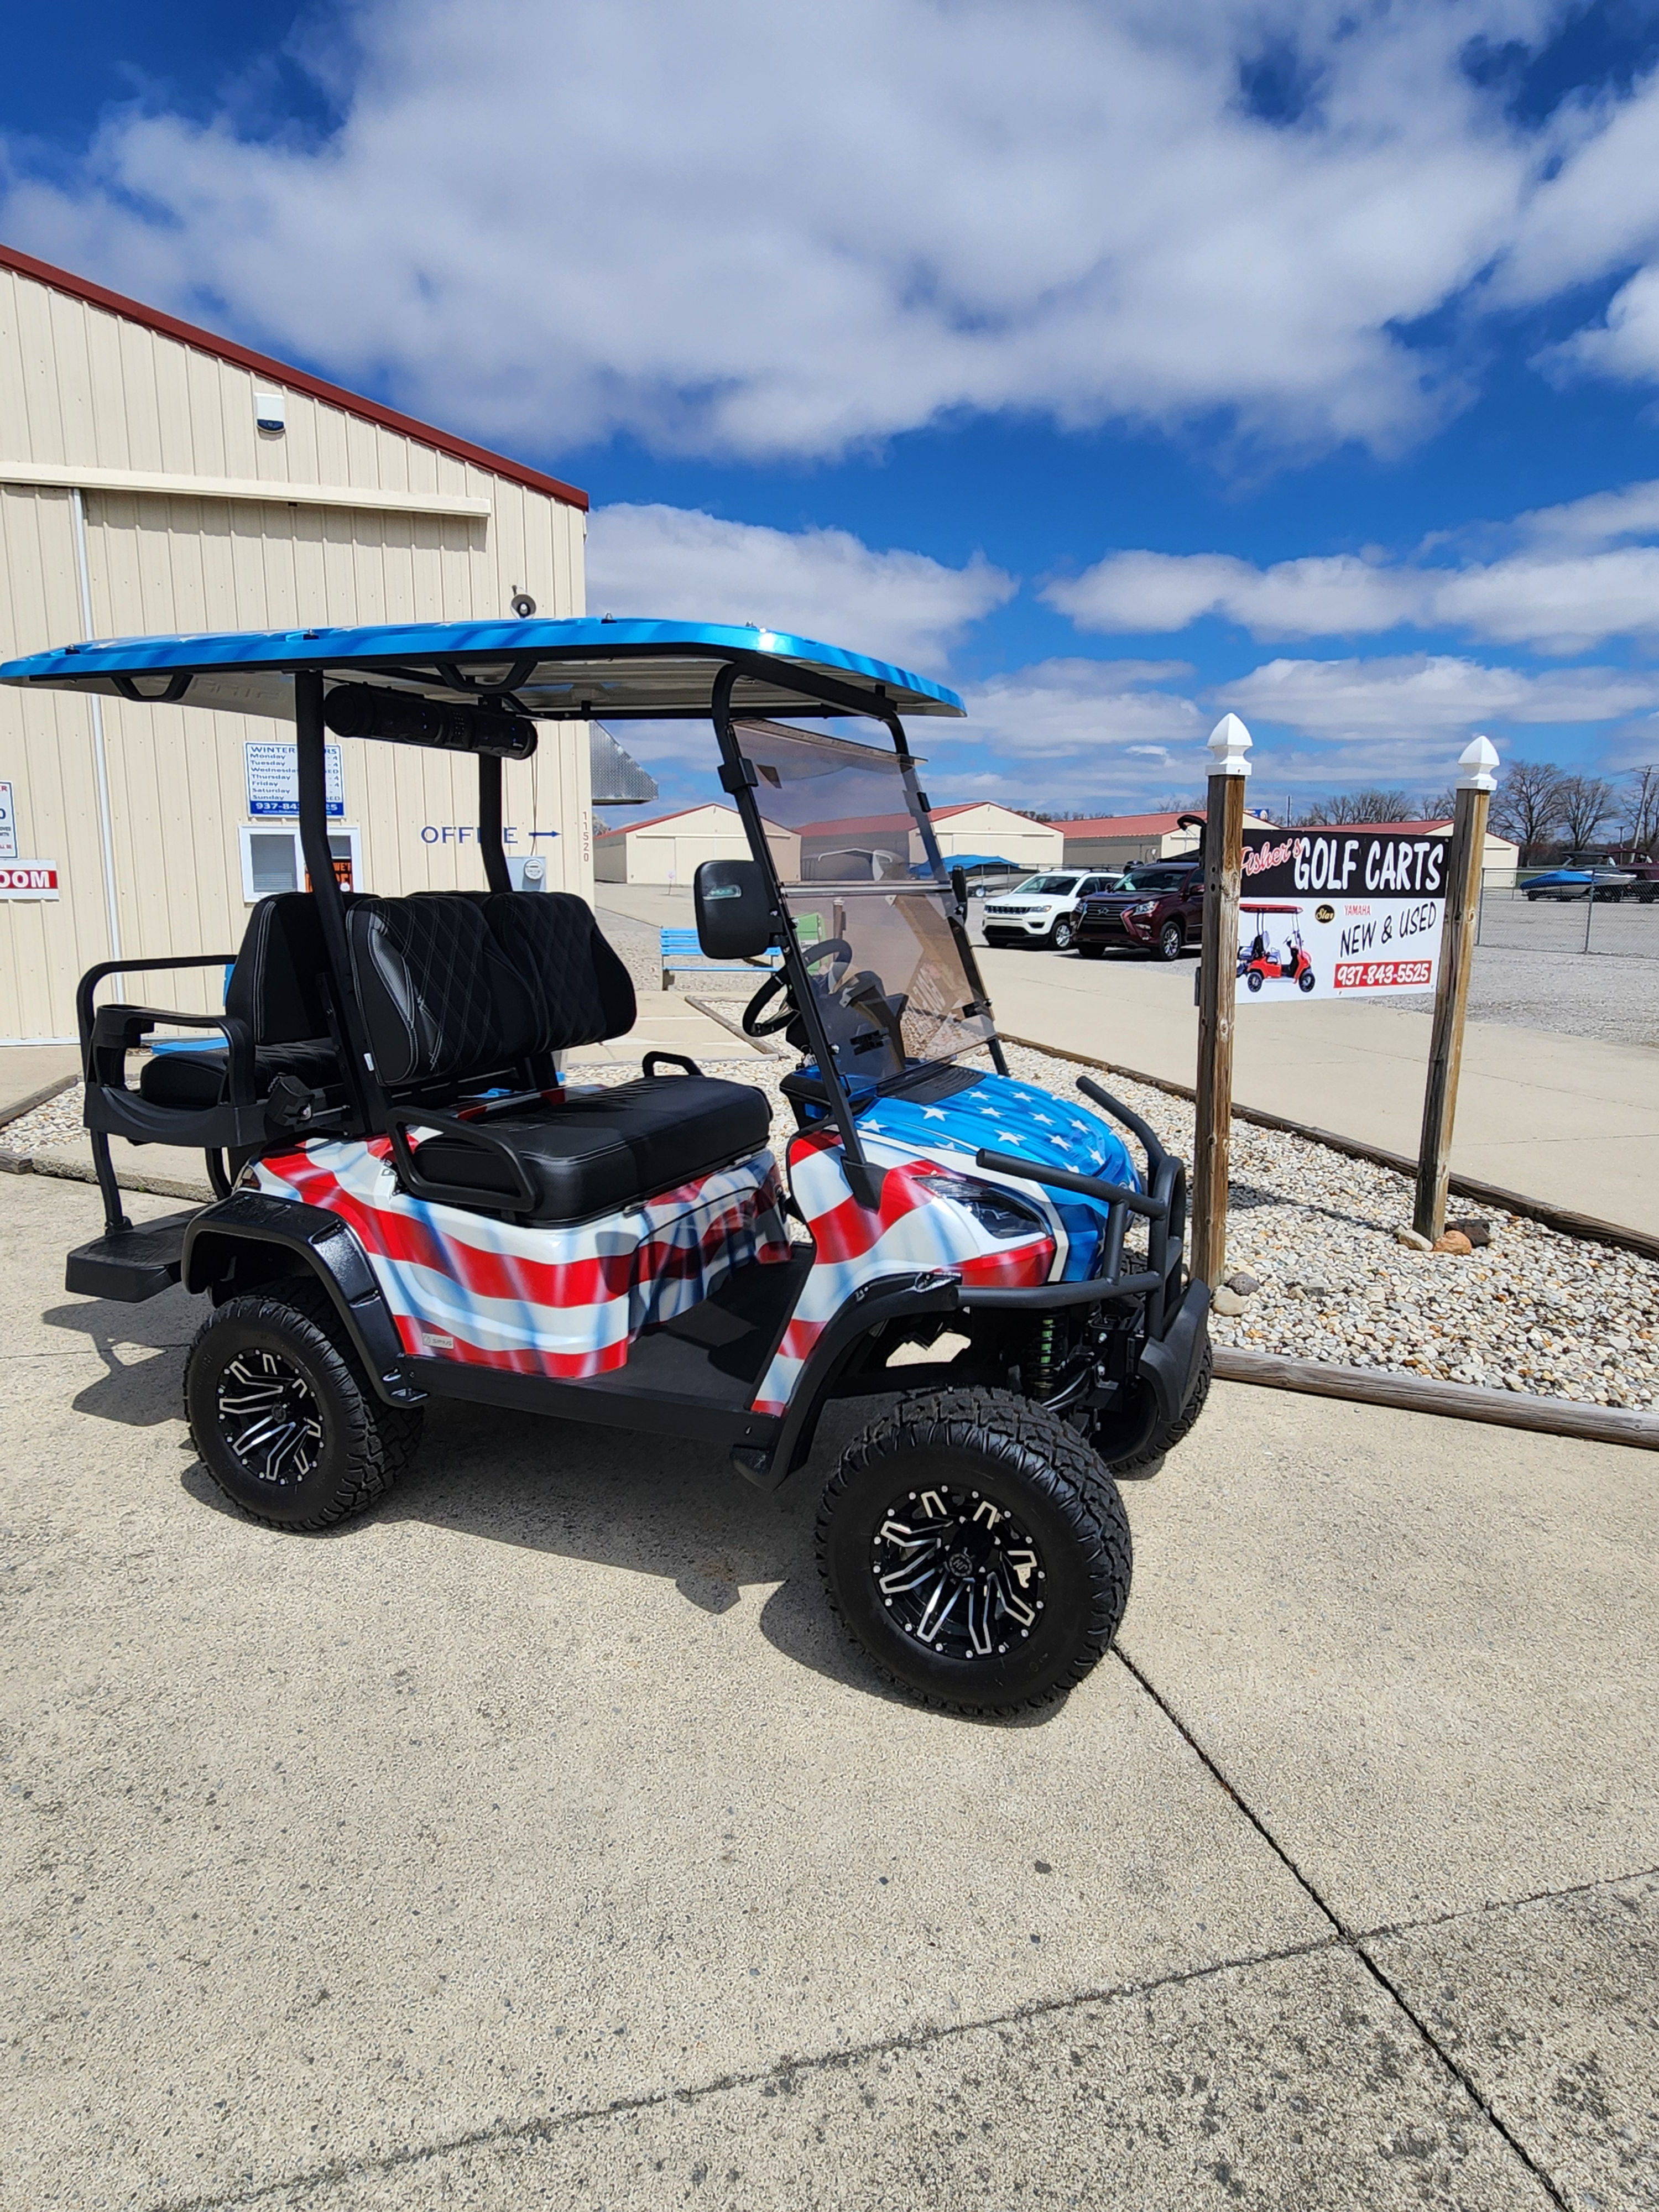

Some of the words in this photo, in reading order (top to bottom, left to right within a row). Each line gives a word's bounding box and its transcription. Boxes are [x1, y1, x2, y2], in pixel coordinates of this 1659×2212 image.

[421, 826, 518, 843] OFFIE
[1295, 837, 1359, 890] GOLF
[1365, 840, 1444, 890] CARTS
[1344, 905, 1370, 915] YAMAHA
[1340, 920, 1376, 958] NEW
[1381, 915, 1392, 944] &
[1399, 901, 1437, 938] USED
[1337, 963, 1430, 985] 937-843-5525
